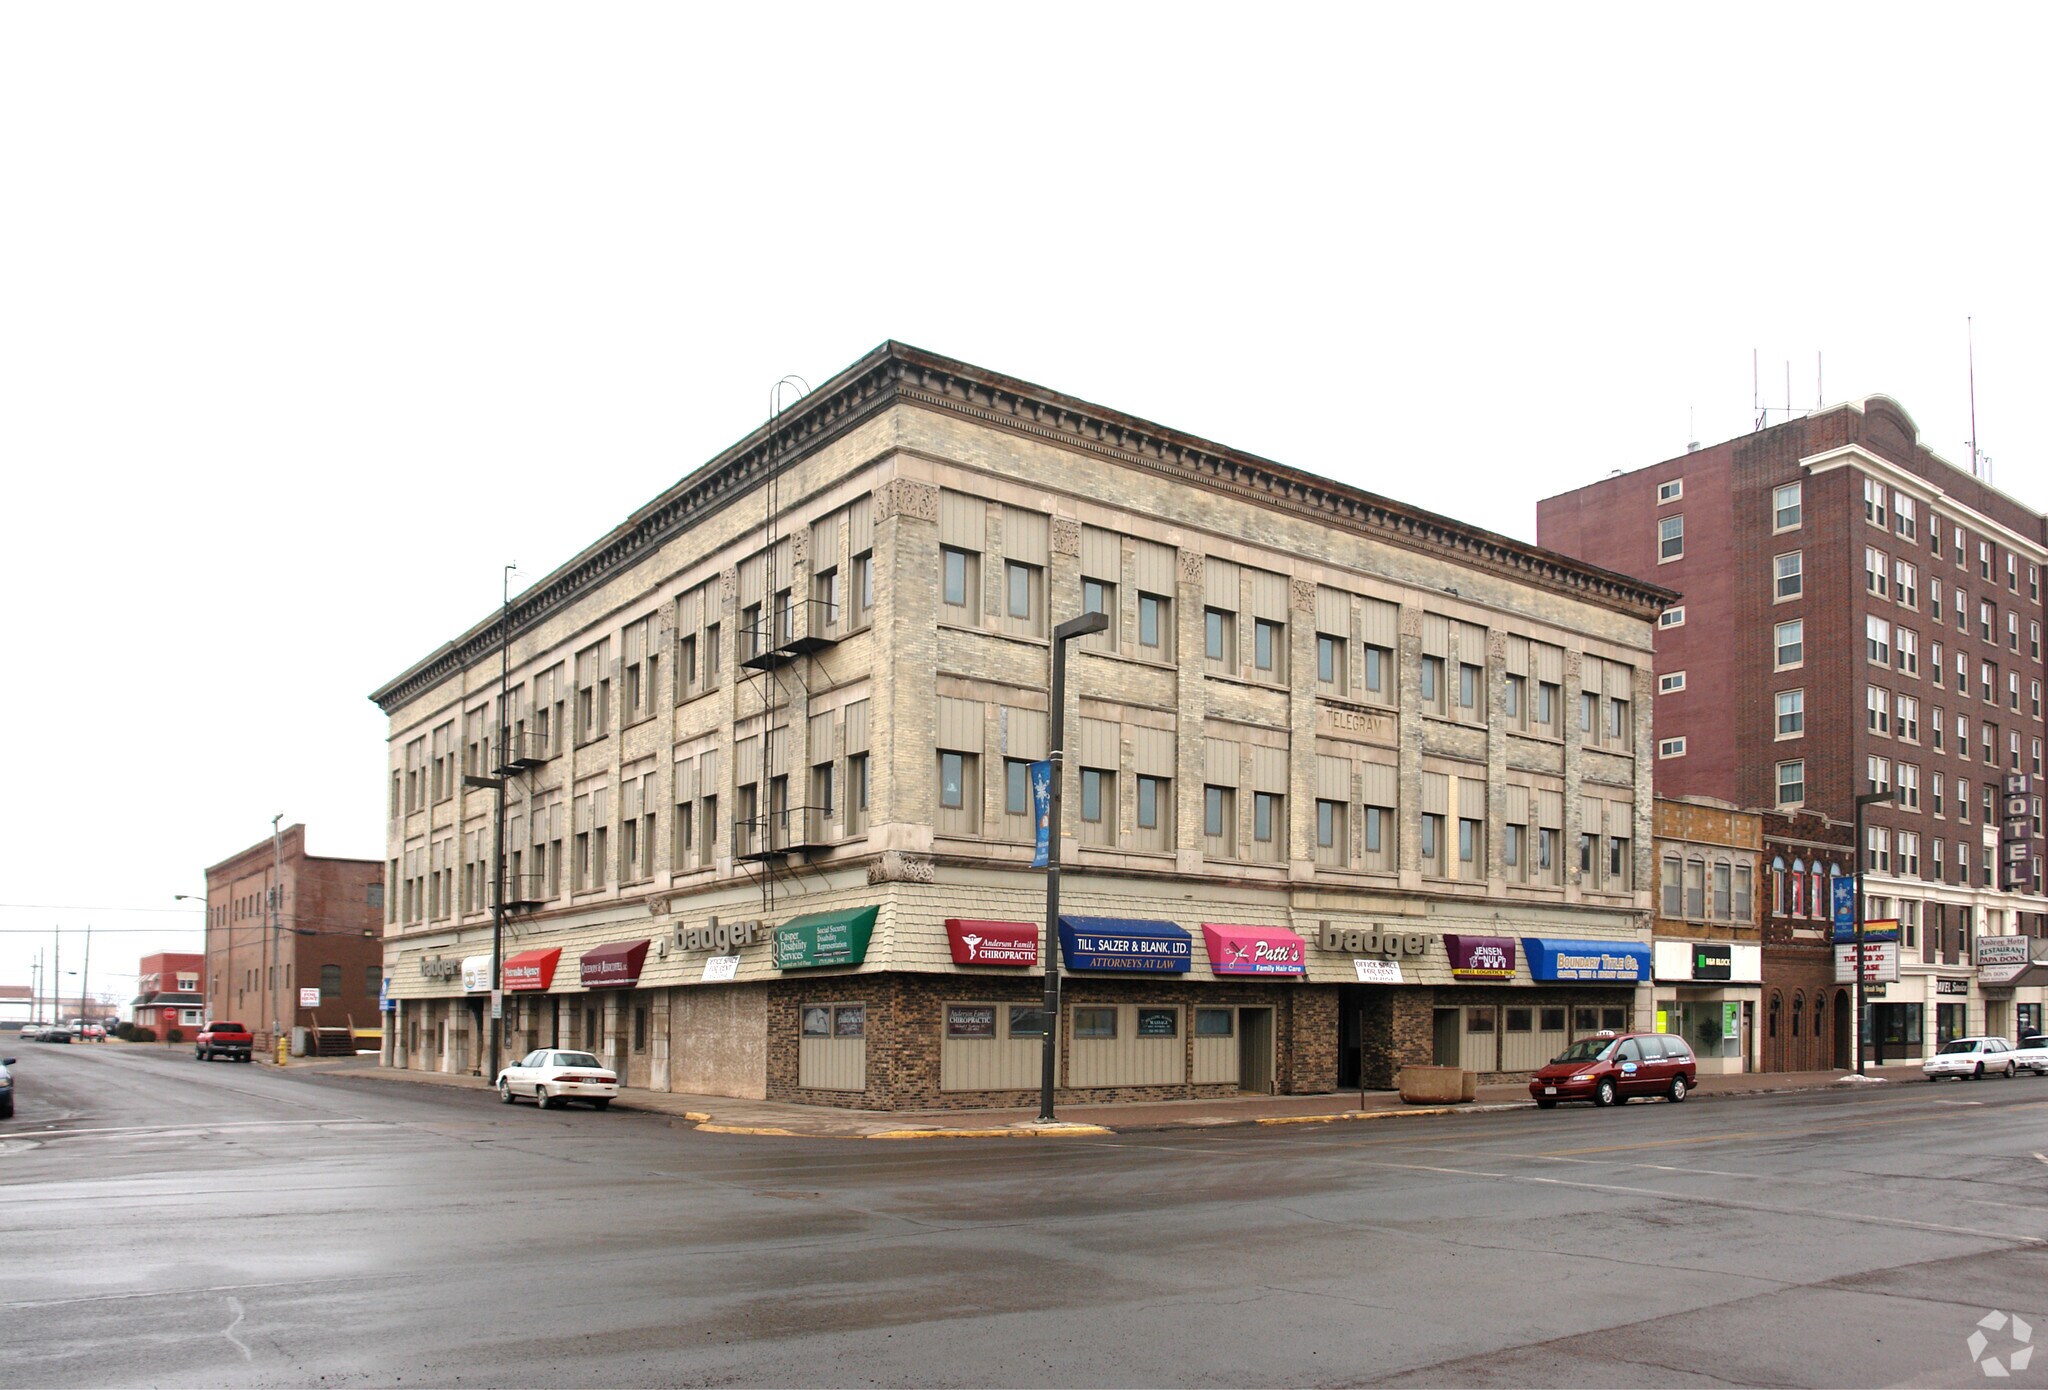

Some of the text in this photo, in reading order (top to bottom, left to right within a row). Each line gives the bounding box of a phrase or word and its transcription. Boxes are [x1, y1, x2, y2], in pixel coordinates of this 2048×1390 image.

[1326, 710, 1382, 734] TELEGRAM
[2008, 775, 2027, 884] HOTEL
[674, 916, 762, 956] badger
[780, 931, 799, 943] Casper
[1319, 920, 1439, 961] badger
[781, 940, 807, 951] Disability
[982, 939, 1036, 949] Anderson Family
[1077, 939, 1189, 954] TILL, SALZER & BLANK, LTD.
[780, 952, 803, 961] Services
[979, 949, 1037, 960] CHIROPRACTIC
[1254, 940, 1300, 962] Patti's
[1474, 947, 1503, 956] JENSEN
[1980, 946, 2026, 956] RESTAURANT
[420, 954, 460, 981] badger
[1089, 957, 1176, 969] ATTORNEYS AT LAW
[1557, 953, 1601, 969] BOUNDARY
[1601, 954, 1624, 970] TITLE
[1716, 958, 1730, 966] BLOCK
[1256, 964, 1275, 973] Family
[950, 1016, 991, 1024] CHIROPRACTIC
